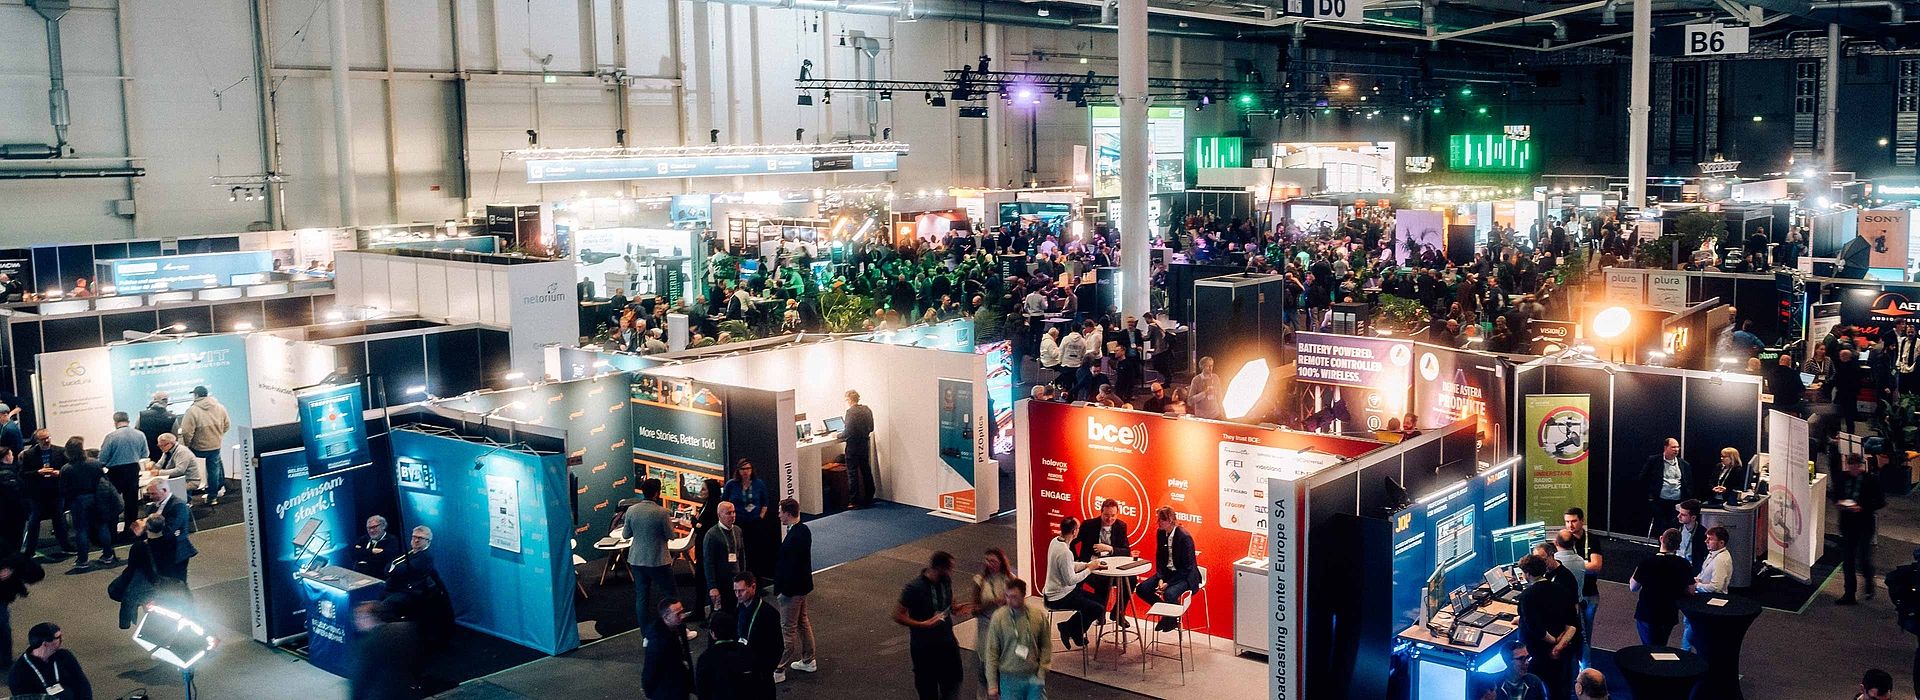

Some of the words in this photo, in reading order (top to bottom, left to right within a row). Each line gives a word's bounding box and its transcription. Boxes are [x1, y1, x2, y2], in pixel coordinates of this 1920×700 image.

[1691, 30, 1724, 53] B6
[1865, 215, 1902, 223] SONY
[1612, 274, 1637, 285] plura
[1654, 276, 1680, 286] plura
[524, 293, 566, 304] netorium
[1298, 342, 1333, 356] BATTERY
[1333, 346, 1375, 360] POWERED.
[1298, 354, 1330, 367] REMOTE
[1297, 366, 1320, 378] 100%
[1321, 369, 1362, 383] WIRELESS.
[1459, 384, 1482, 399] ASTERA
[639, 426, 656, 439] More
[656, 429, 680, 445] Stories,
[680, 433, 701, 448] Better
[701, 437, 716, 450] Told
[978, 415, 986, 463] PTZOptics
[1087, 416, 1134, 445] bce
[243, 438, 252, 493] Solutions
[276, 476, 345, 520] gemeinsam
[1041, 489, 1072, 502] ENGAGE
[293, 490, 336, 524] stark!
[1094, 500, 1137, 517] SICE
[1174, 511, 1203, 524] RIBUTE
[1274, 498, 1286, 519] SA
[246, 495, 258, 567] Productions
[1275, 522, 1288, 573] Europe
[250, 570, 262, 629] Videndum
[1275, 576, 1286, 622] Center
